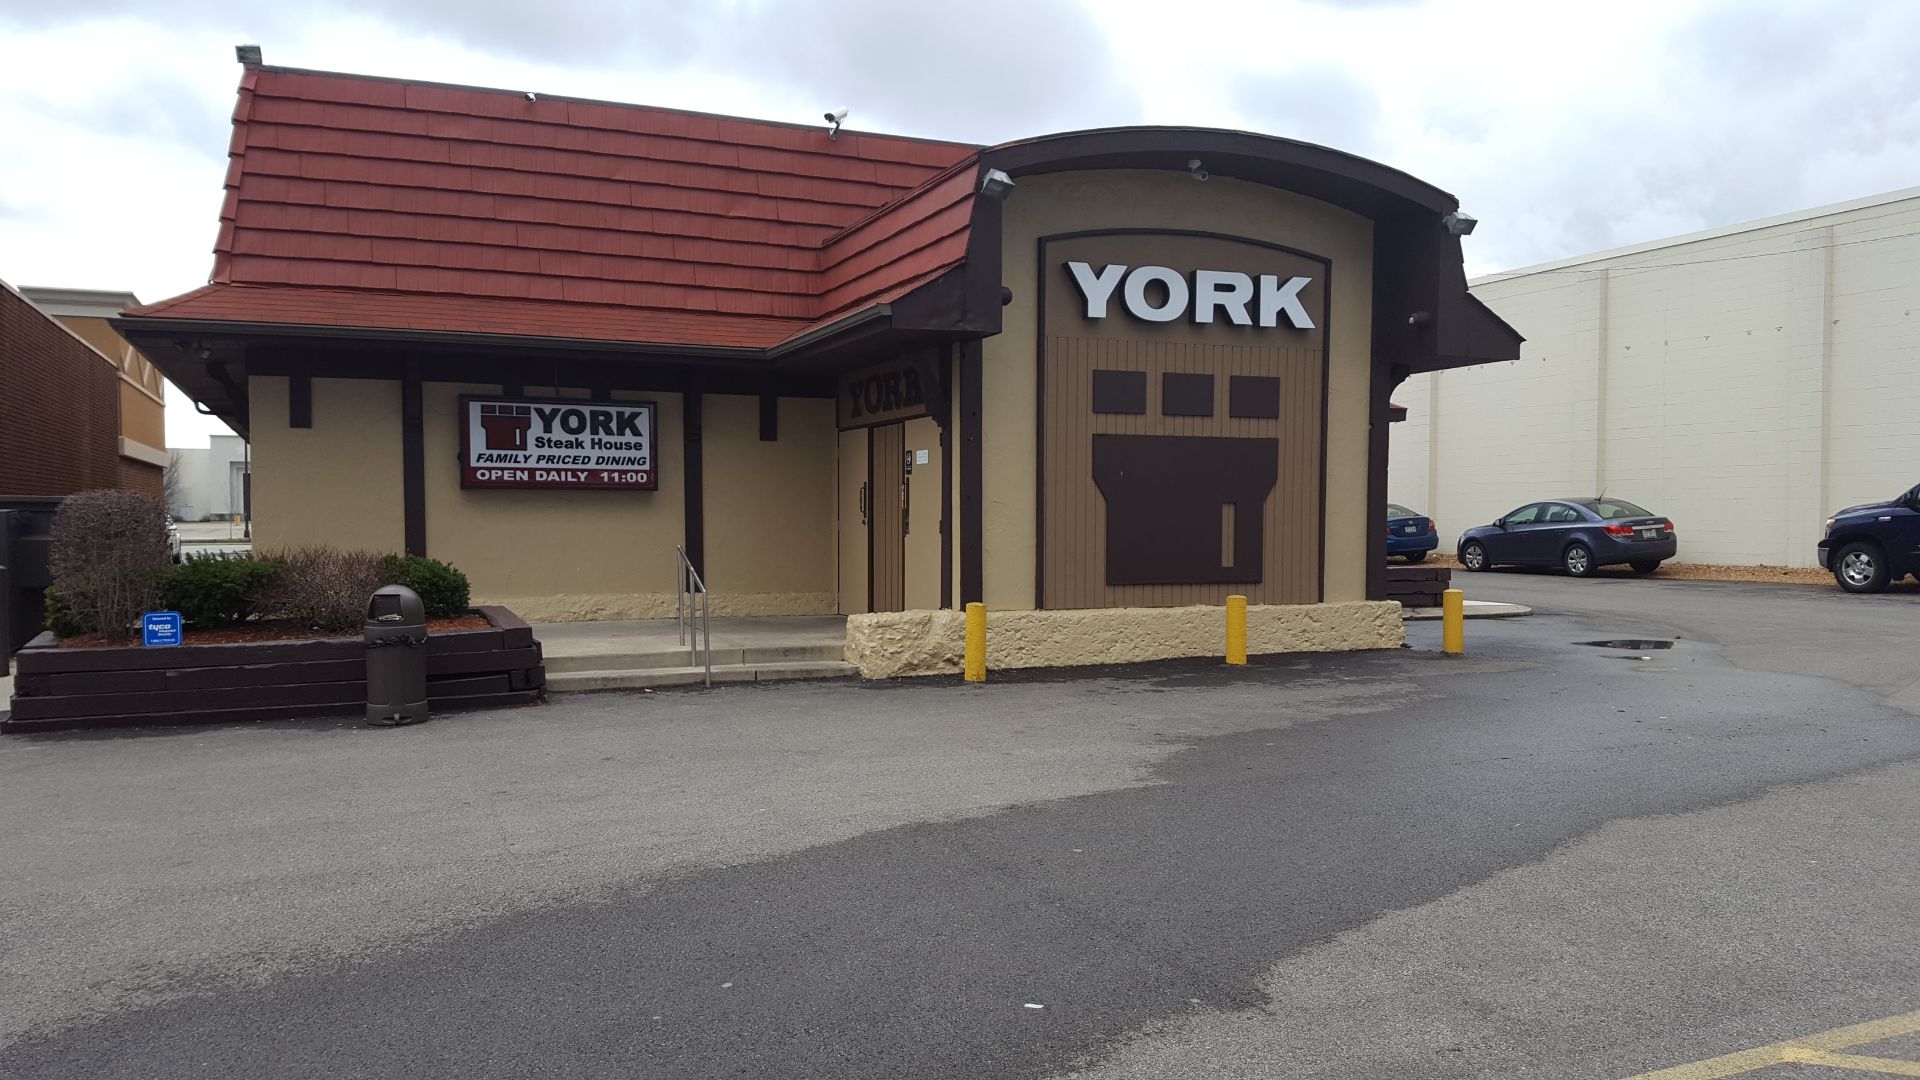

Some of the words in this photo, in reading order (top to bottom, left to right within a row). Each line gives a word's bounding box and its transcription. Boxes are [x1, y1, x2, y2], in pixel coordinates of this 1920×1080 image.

[1064, 261, 1316, 329] YORK
[533, 407, 643, 437] YORK
[534, 436, 585, 450] Steak
[591, 438, 643, 451] House
[476, 453, 533, 464] FAMILY
[536, 454, 591, 465] PRICED
[595, 455, 647, 466] DINING
[476, 469, 529, 481] OPEN
[535, 470, 589, 482] DAILY
[600, 472, 648, 483] 11:00
